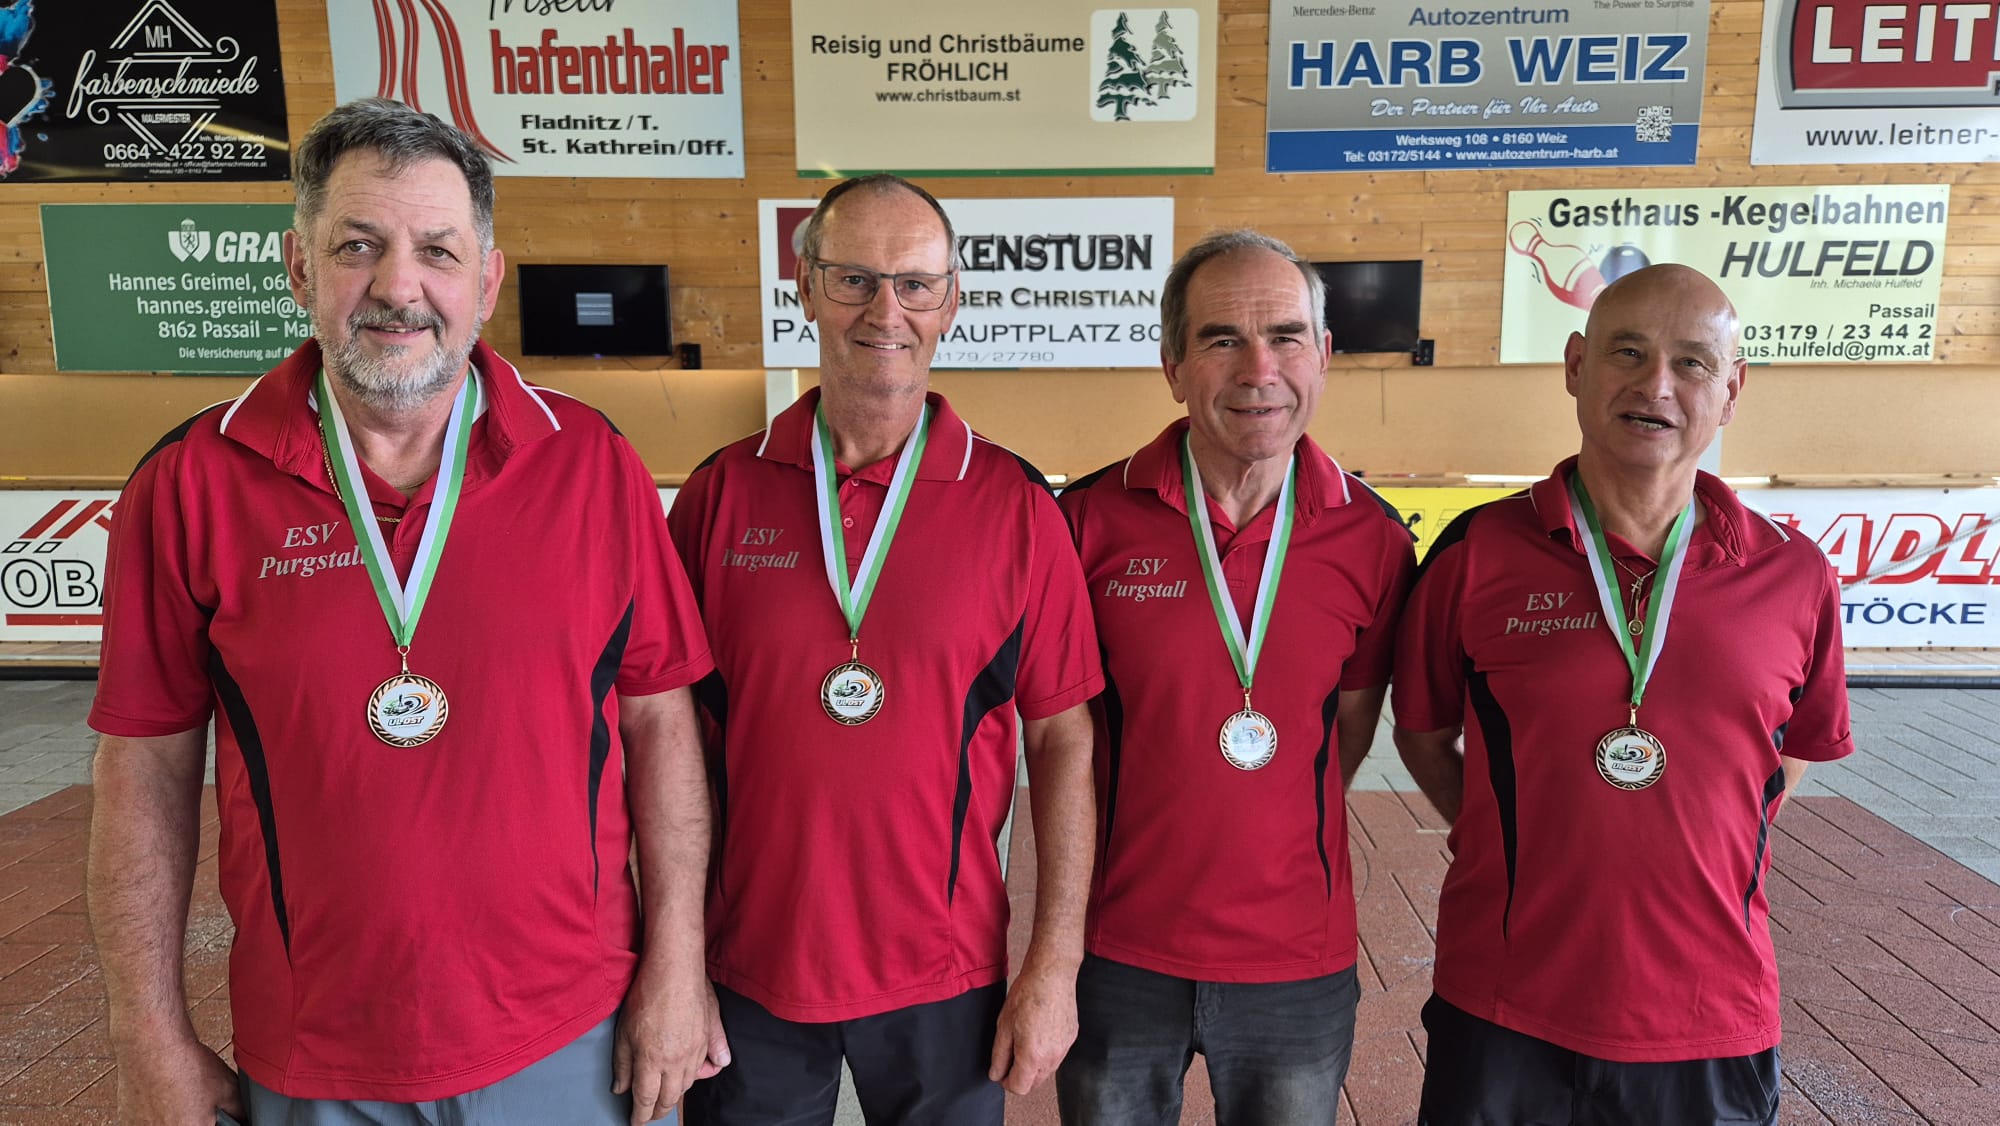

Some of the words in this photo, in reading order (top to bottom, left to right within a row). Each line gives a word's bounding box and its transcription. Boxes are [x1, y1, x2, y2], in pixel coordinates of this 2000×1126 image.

[1292, 4, 1377, 16] Mercedes-Benz
[1408, 6, 1569, 27] Autozentrum
[145, 26, 172, 48] MH
[1812, 3, 2000, 63] LEIT
[811, 34, 881, 58] Reisig
[889, 35, 931, 54] und
[939, 33, 1085, 54] Christbäume
[489, 28, 729, 95] hafenthaler
[887, 58, 1009, 82] FRÖHLICH
[1288, 39, 1483, 90] HARB
[1506, 33, 1691, 87] WEIZ
[66, 50, 259, 118] farbenschmiede
[876, 88, 1021, 103] www.christbaum.st
[1371, 98, 1404, 117] Der
[1411, 98, 1479, 117] Partner
[1483, 99, 1512, 120] für
[1520, 96, 1548, 114] Ihr
[1553, 97, 1600, 114] Auto
[523, 139, 557, 154] St.
[567, 138, 734, 156] Kathrein/Off.
[1396, 134, 1462, 148] Werksweg
[1465, 134, 1488, 145] 108
[1502, 133, 1534, 145] 8160
[1537, 132, 1568, 144] Weiz
[104, 143, 150, 160] 0664
[169, 143, 205, 160] 422
[210, 143, 235, 159] 92
[241, 143, 266, 159] 22
[1367, 150, 1441, 163] 03172/5144
[1456, 147, 1619, 161] www.autozentrum-harb.at
[1548, 198, 1699, 227] Gasthaus
[215, 231, 286, 263] GRA
[957, 234, 1153, 272] KENSTUBN
[1719, 240, 1934, 278] HULFELD
[109, 273, 177, 291] Hannes
[181, 273, 257, 293] Greimel,
[1810, 280, 1829, 289] Inh.
[1833, 279, 1882, 289] Michaela
[1884, 278, 1923, 288] Hulfeld
[137, 296, 308, 319] hannes.greimel@g
[774, 288, 799, 307] IN
[959, 290, 1003, 307] BER
[1869, 303, 1935, 318] Passail
[158, 321, 197, 338] 8162
[203, 320, 260, 338] Passail
[773, 319, 817, 343] PA
[940, 324, 1121, 343] AUPTPLATZ
[1744, 324, 1818, 341] 03179
[1843, 324, 1871, 339] 23
[1880, 324, 1909, 339] 44
[1919, 324, 1932, 339] 2
[179, 347, 196, 359] Die
[198, 347, 263, 361] Versicherung
[265, 347, 282, 358] auf
[935, 351, 1055, 363] 3179/27780
[1736, 340, 1930, 361] aus.hulfeld@gmx.at
[282, 521, 340, 549] ESV
[741, 527, 784, 545] ESV
[721, 548, 800, 572] Purgstall
[1770, 513, 2000, 585] ADL
[257, 544, 365, 579] Purgstal
[1124, 558, 1168, 576] ESV
[0, 541, 103, 608] ÖB
[1104, 580, 1187, 602] Purgstall
[1526, 592, 1574, 611] ESV
[1839, 597, 1987, 625] TÖCKE
[1504, 612, 1600, 636] Purgstall
